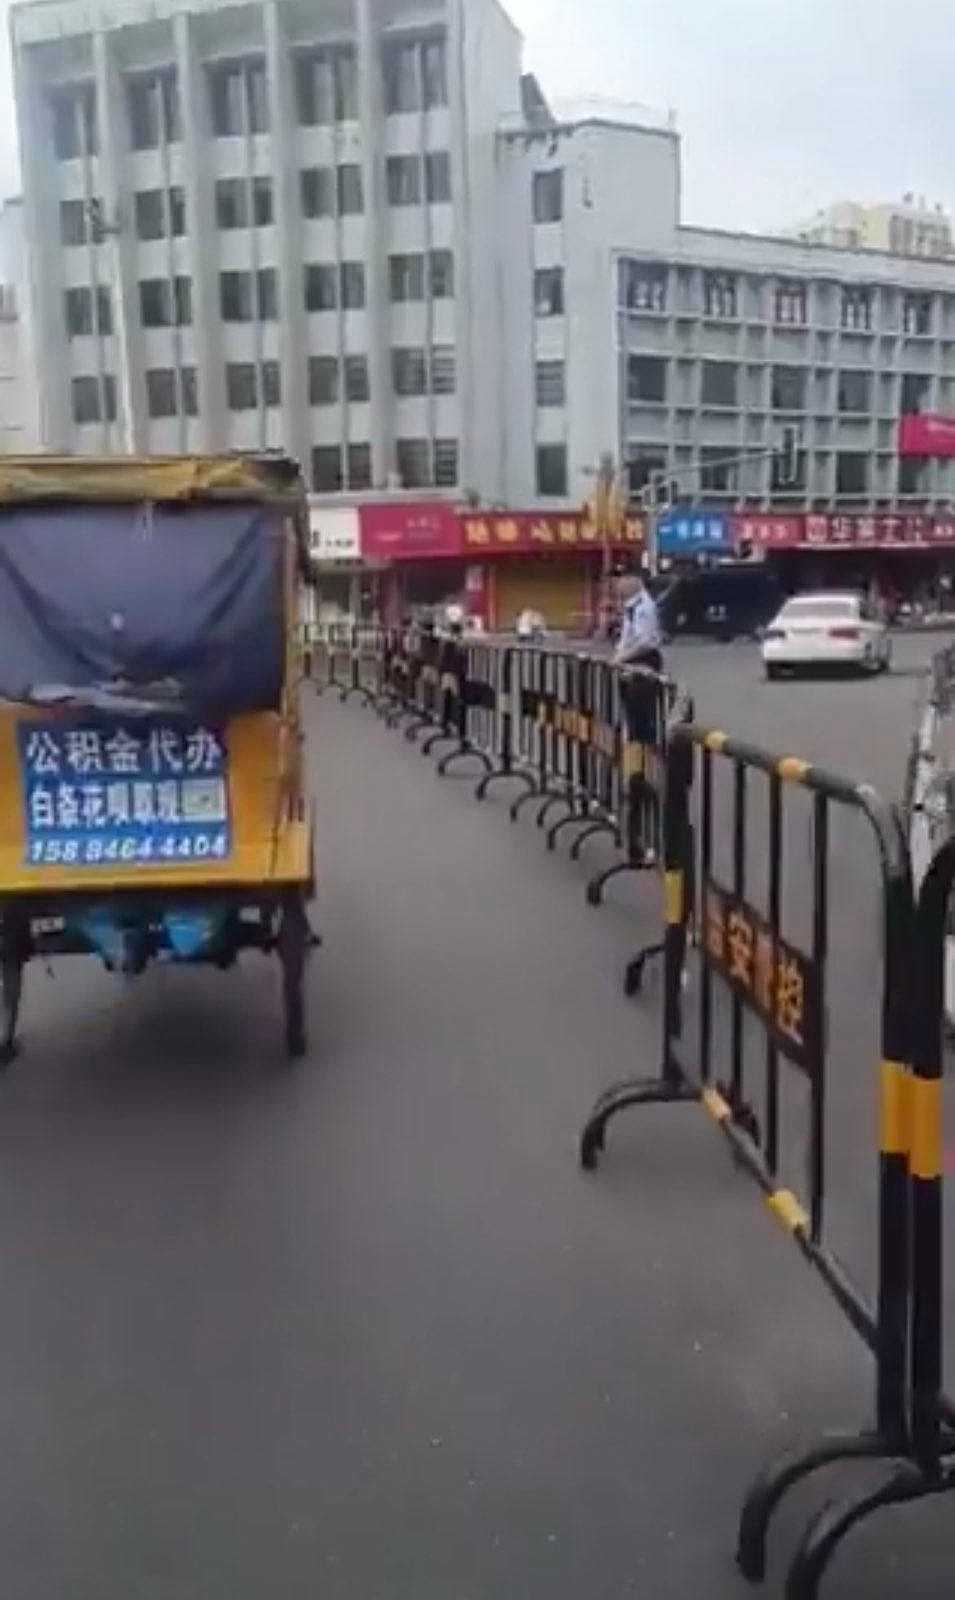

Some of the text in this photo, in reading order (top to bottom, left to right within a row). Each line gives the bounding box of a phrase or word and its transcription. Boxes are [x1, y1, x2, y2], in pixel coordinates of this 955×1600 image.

[27, 726, 222, 772] 公积金代办
[31, 838, 79, 861] 158
[160, 832, 226, 858] 4404
